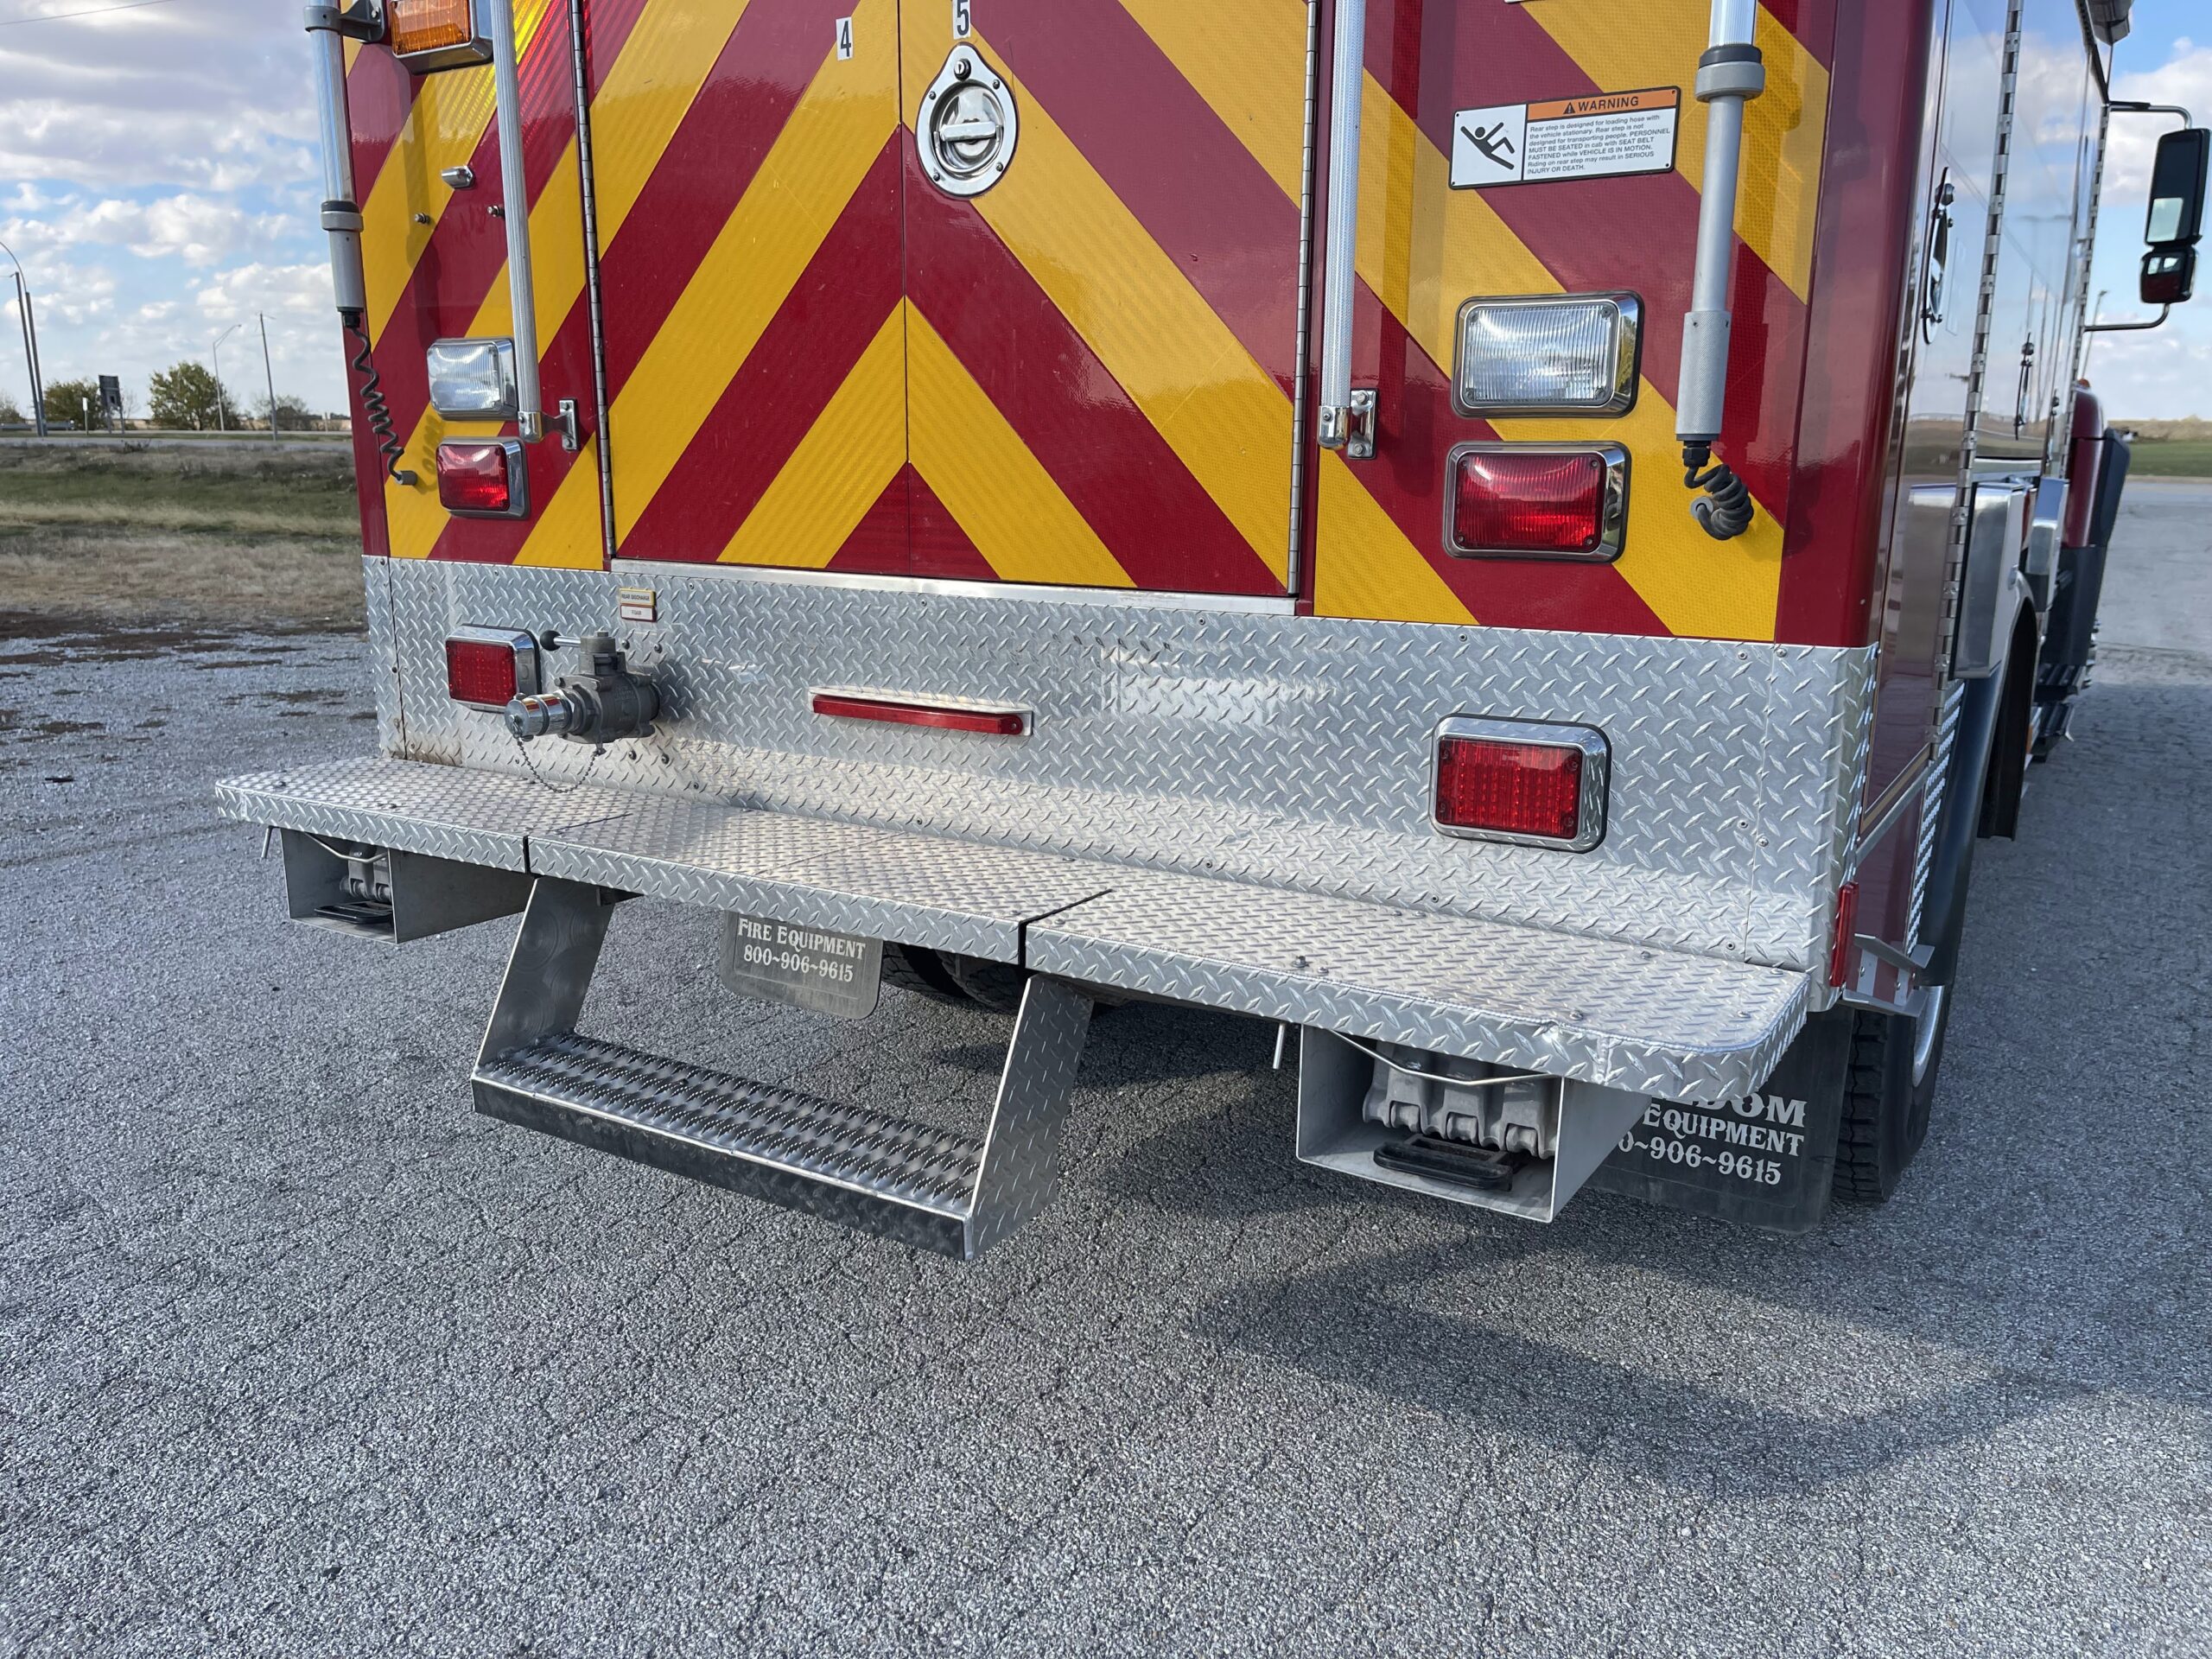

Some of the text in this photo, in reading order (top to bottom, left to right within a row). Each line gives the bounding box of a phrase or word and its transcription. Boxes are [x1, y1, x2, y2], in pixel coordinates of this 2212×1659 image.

[957, 0, 969, 35] 5
[841, 21, 851, 57] 4
[1578, 97, 1638, 111] WARNING
[1630, 128, 1670, 137] PERSONNEL
[738, 918, 866, 960] FIRE EQUIPMENT
[1642, 1103, 1804, 1156] EQUIPMENT
